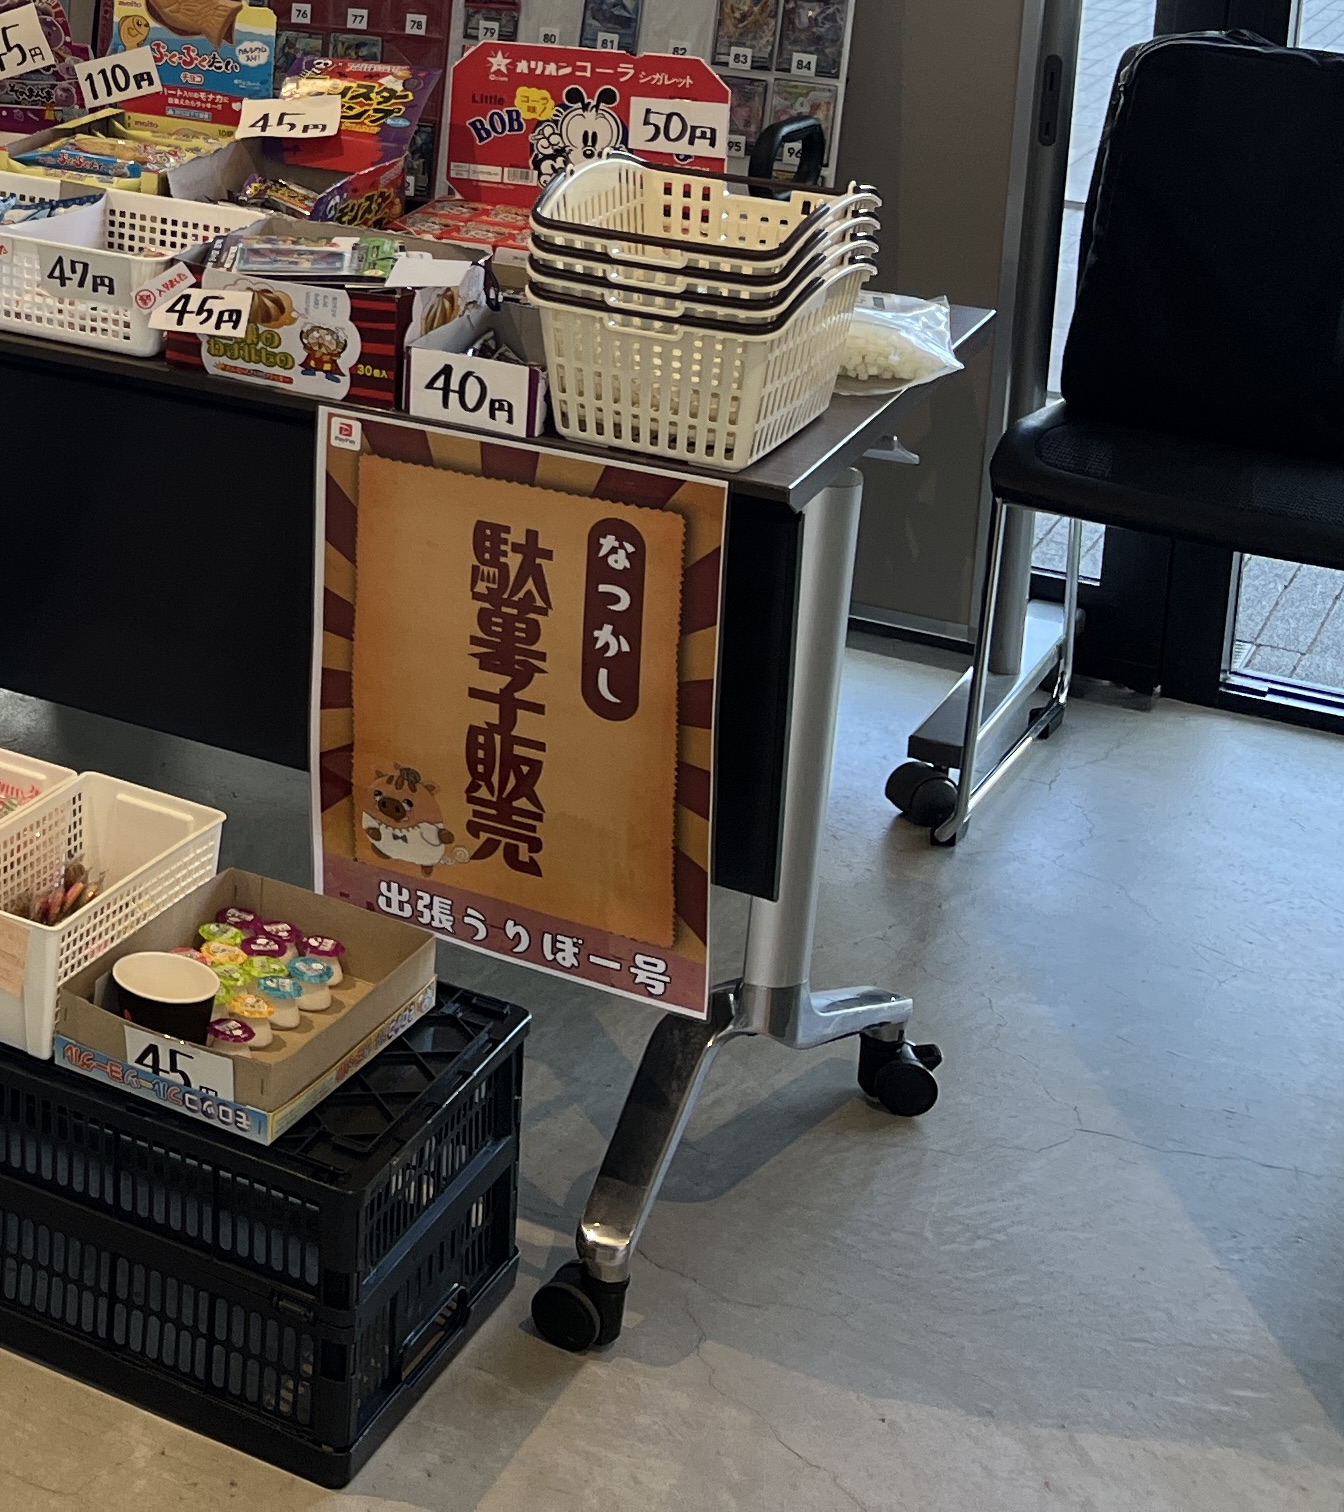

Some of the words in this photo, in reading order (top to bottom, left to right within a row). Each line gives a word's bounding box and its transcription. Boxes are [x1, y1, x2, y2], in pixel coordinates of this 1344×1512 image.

[295, 8, 309, 19] 76
[351, 13, 365, 25] 77
[409, 19, 423, 31] 78
[733, 53, 749, 65] 83
[795, 59, 812, 72] 84
[82, 64, 156, 103] 110円
[180, 71, 205, 85] チョコ
[247, 109, 329, 135] 45円
[469, 108, 525, 144] BOB
[642, 107, 718, 149] 50円
[46, 256, 115, 296] 47円
[164, 291, 244, 332] 45円
[423, 362, 514, 424] 40円
[596, 533, 637, 705] なつかし
[465, 518, 555, 879] 駄菓子販売
[377, 879, 671, 997] 出張うりぼー号
